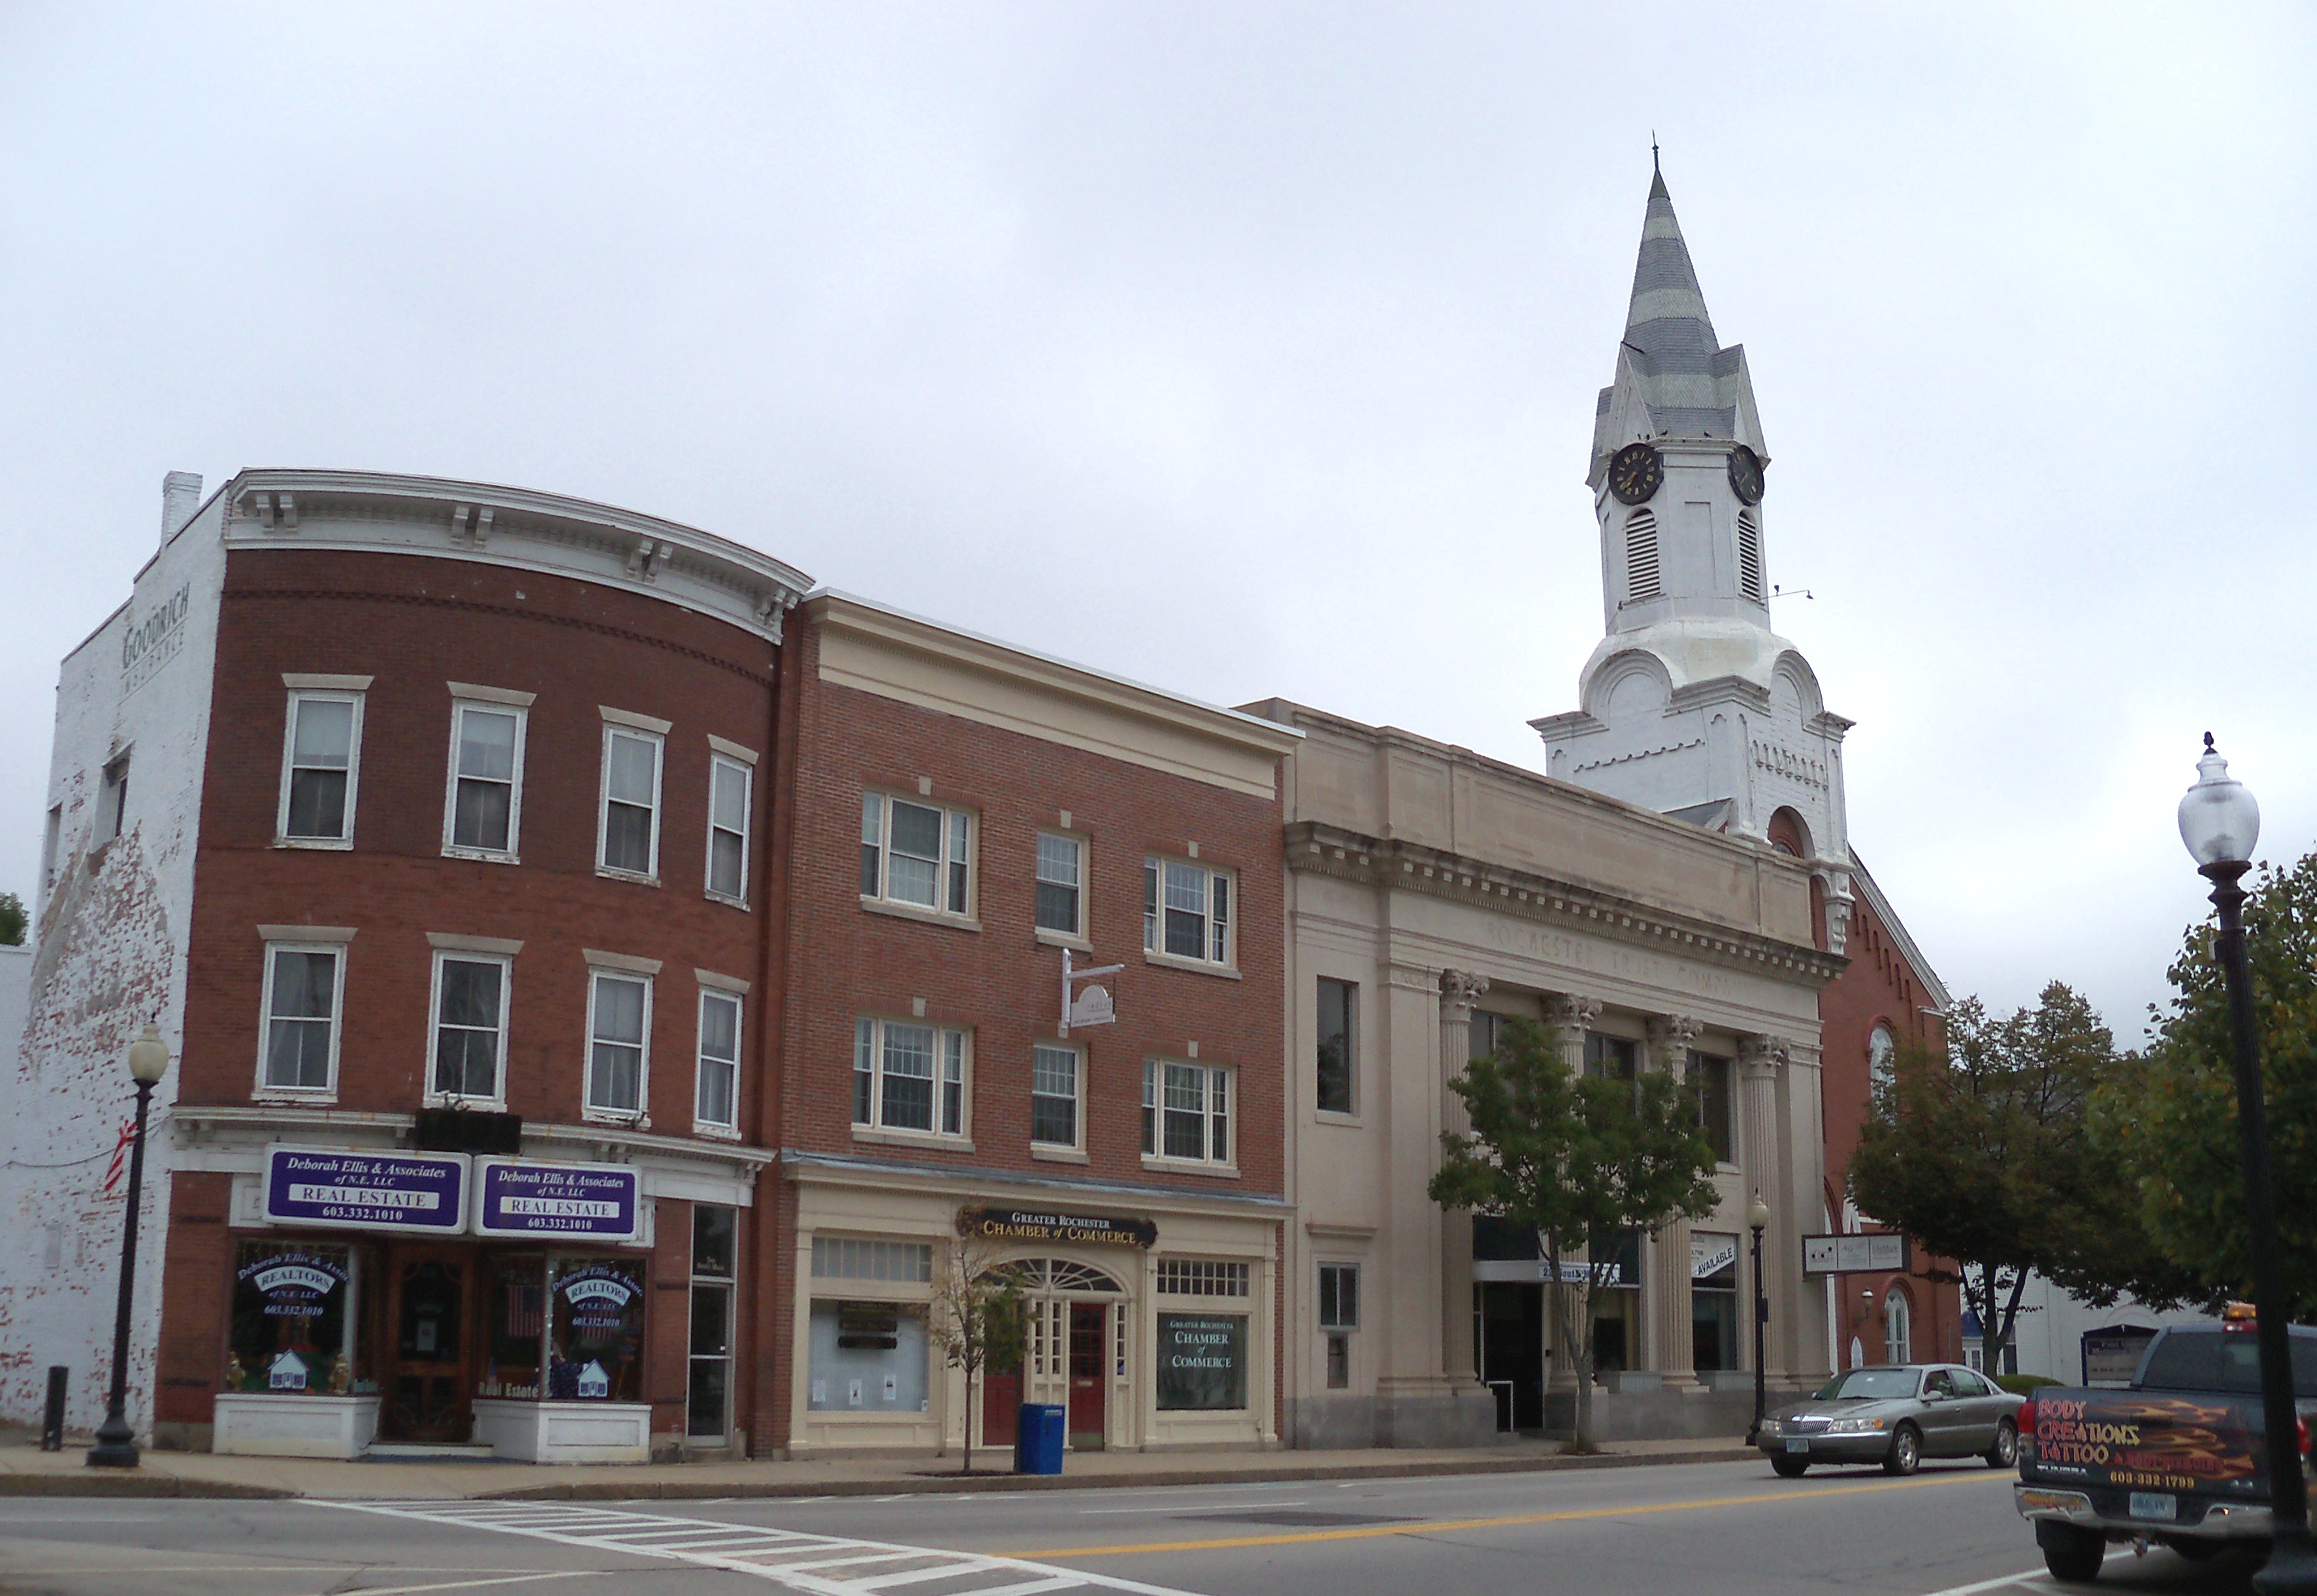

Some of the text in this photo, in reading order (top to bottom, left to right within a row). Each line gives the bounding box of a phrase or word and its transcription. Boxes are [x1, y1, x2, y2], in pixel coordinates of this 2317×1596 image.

[123, 582, 190, 669] GOODRICH
[287, 1157, 446, 1177] Deborah Ellis & Associates
[335, 1175, 395, 1186] of N.E. LLC
[498, 1170, 624, 1188] Deborah Ellis & Associates
[303, 1188, 426, 1207] REAL ESTATE
[537, 1187, 586, 1197] of N.E. LLC
[323, 1206, 402, 1221] 603.332.1010
[512, 1200, 609, 1216] REAL ESTATE
[528, 1218, 592, 1230] 603.332.1010
[1012, 1211, 1110, 1229] GREATER ROCHESTER
[983, 1219, 1136, 1244] CHAMBER of COMMERCE
[238, 1254, 282, 1280] Deborah
[284, 1253, 309, 1262] Ellis
[312, 1256, 321, 1266] &
[1698, 1247, 1732, 1275] AVAILABLE
[262, 1269, 330, 1290] REALTORS
[590, 1266, 610, 1275] Ellis
[611, 1271, 619, 1279] &
[300, 1290, 319, 1299] LLC
[572, 1283, 627, 1301] REALTORS
[264, 1305, 324, 1316] 603.332.1010
[1170, 1320, 1234, 1329] GREATER ROCHESTER
[1175, 1331, 1228, 1344] CHAMBER
[1197, 1345, 1206, 1357] of
[1173, 1354, 1232, 1368] COMMERCE
[2038, 1398, 2086, 1421] BODY
[2037, 1420, 2141, 1446] CREATIONS
[2037, 1441, 2109, 1465] TATTOO
